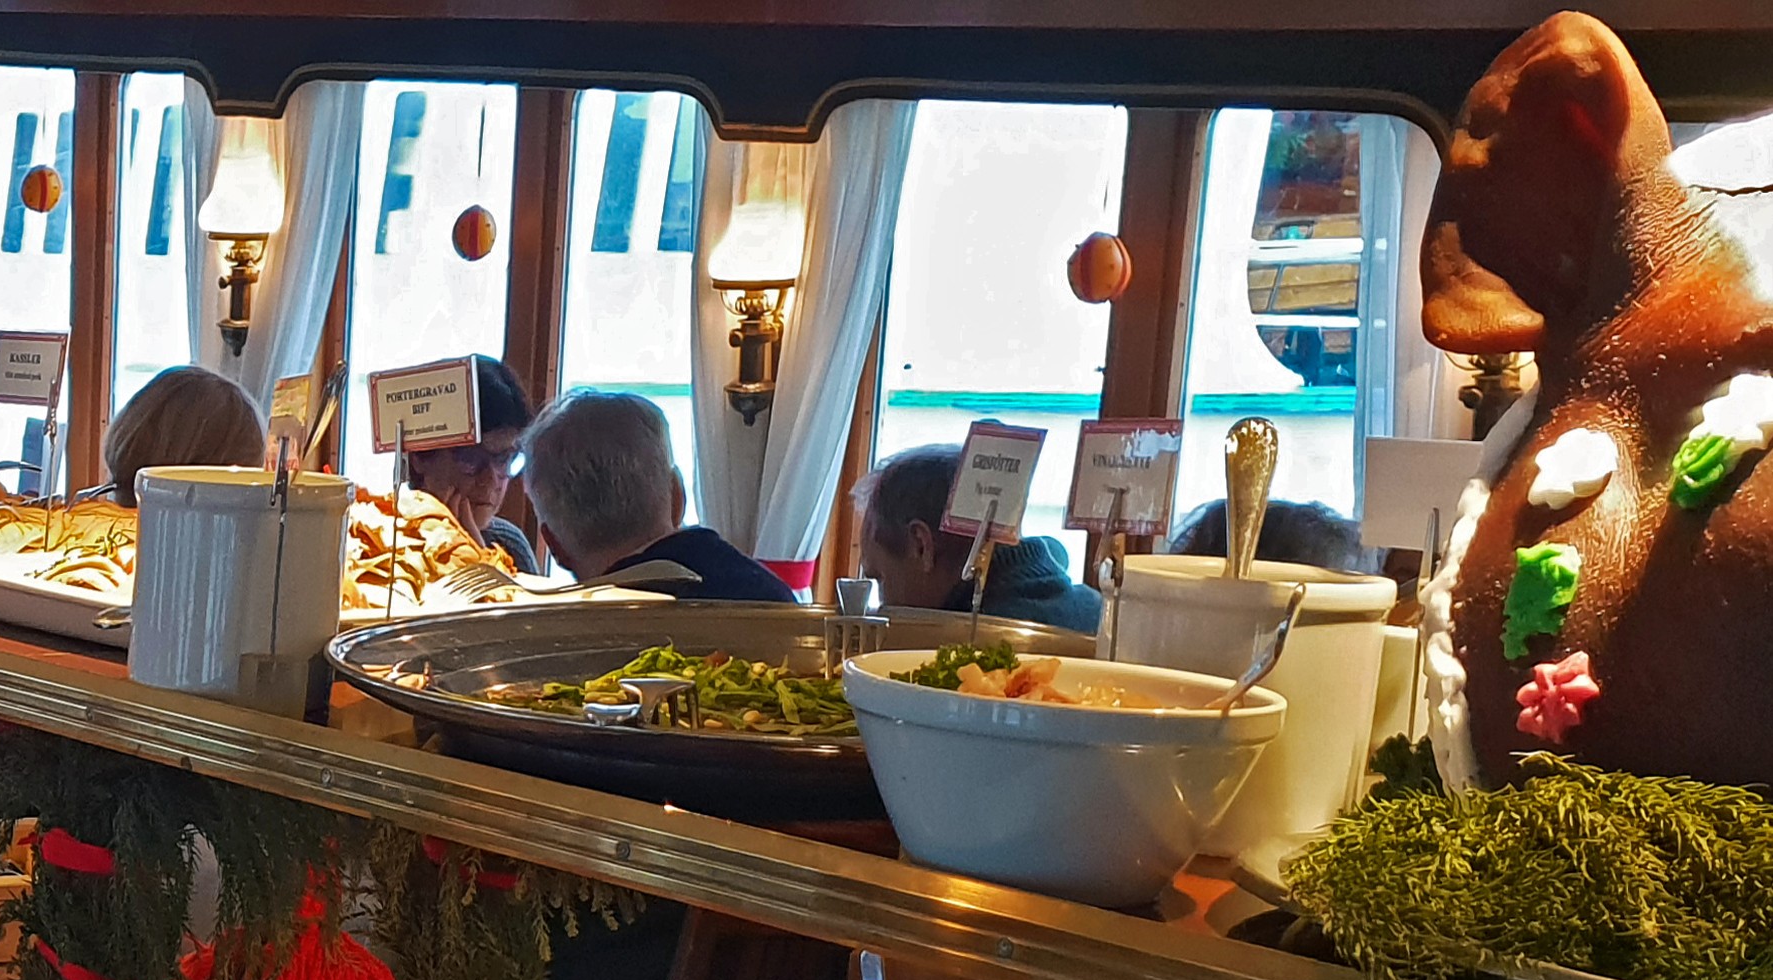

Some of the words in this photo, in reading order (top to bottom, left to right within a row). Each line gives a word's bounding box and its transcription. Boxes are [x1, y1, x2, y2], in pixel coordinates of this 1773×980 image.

[9, 352, 41, 365] KASSLER
[385, 382, 457, 403] PORTERGRAVAD
[412, 402, 432, 415] BIFF
